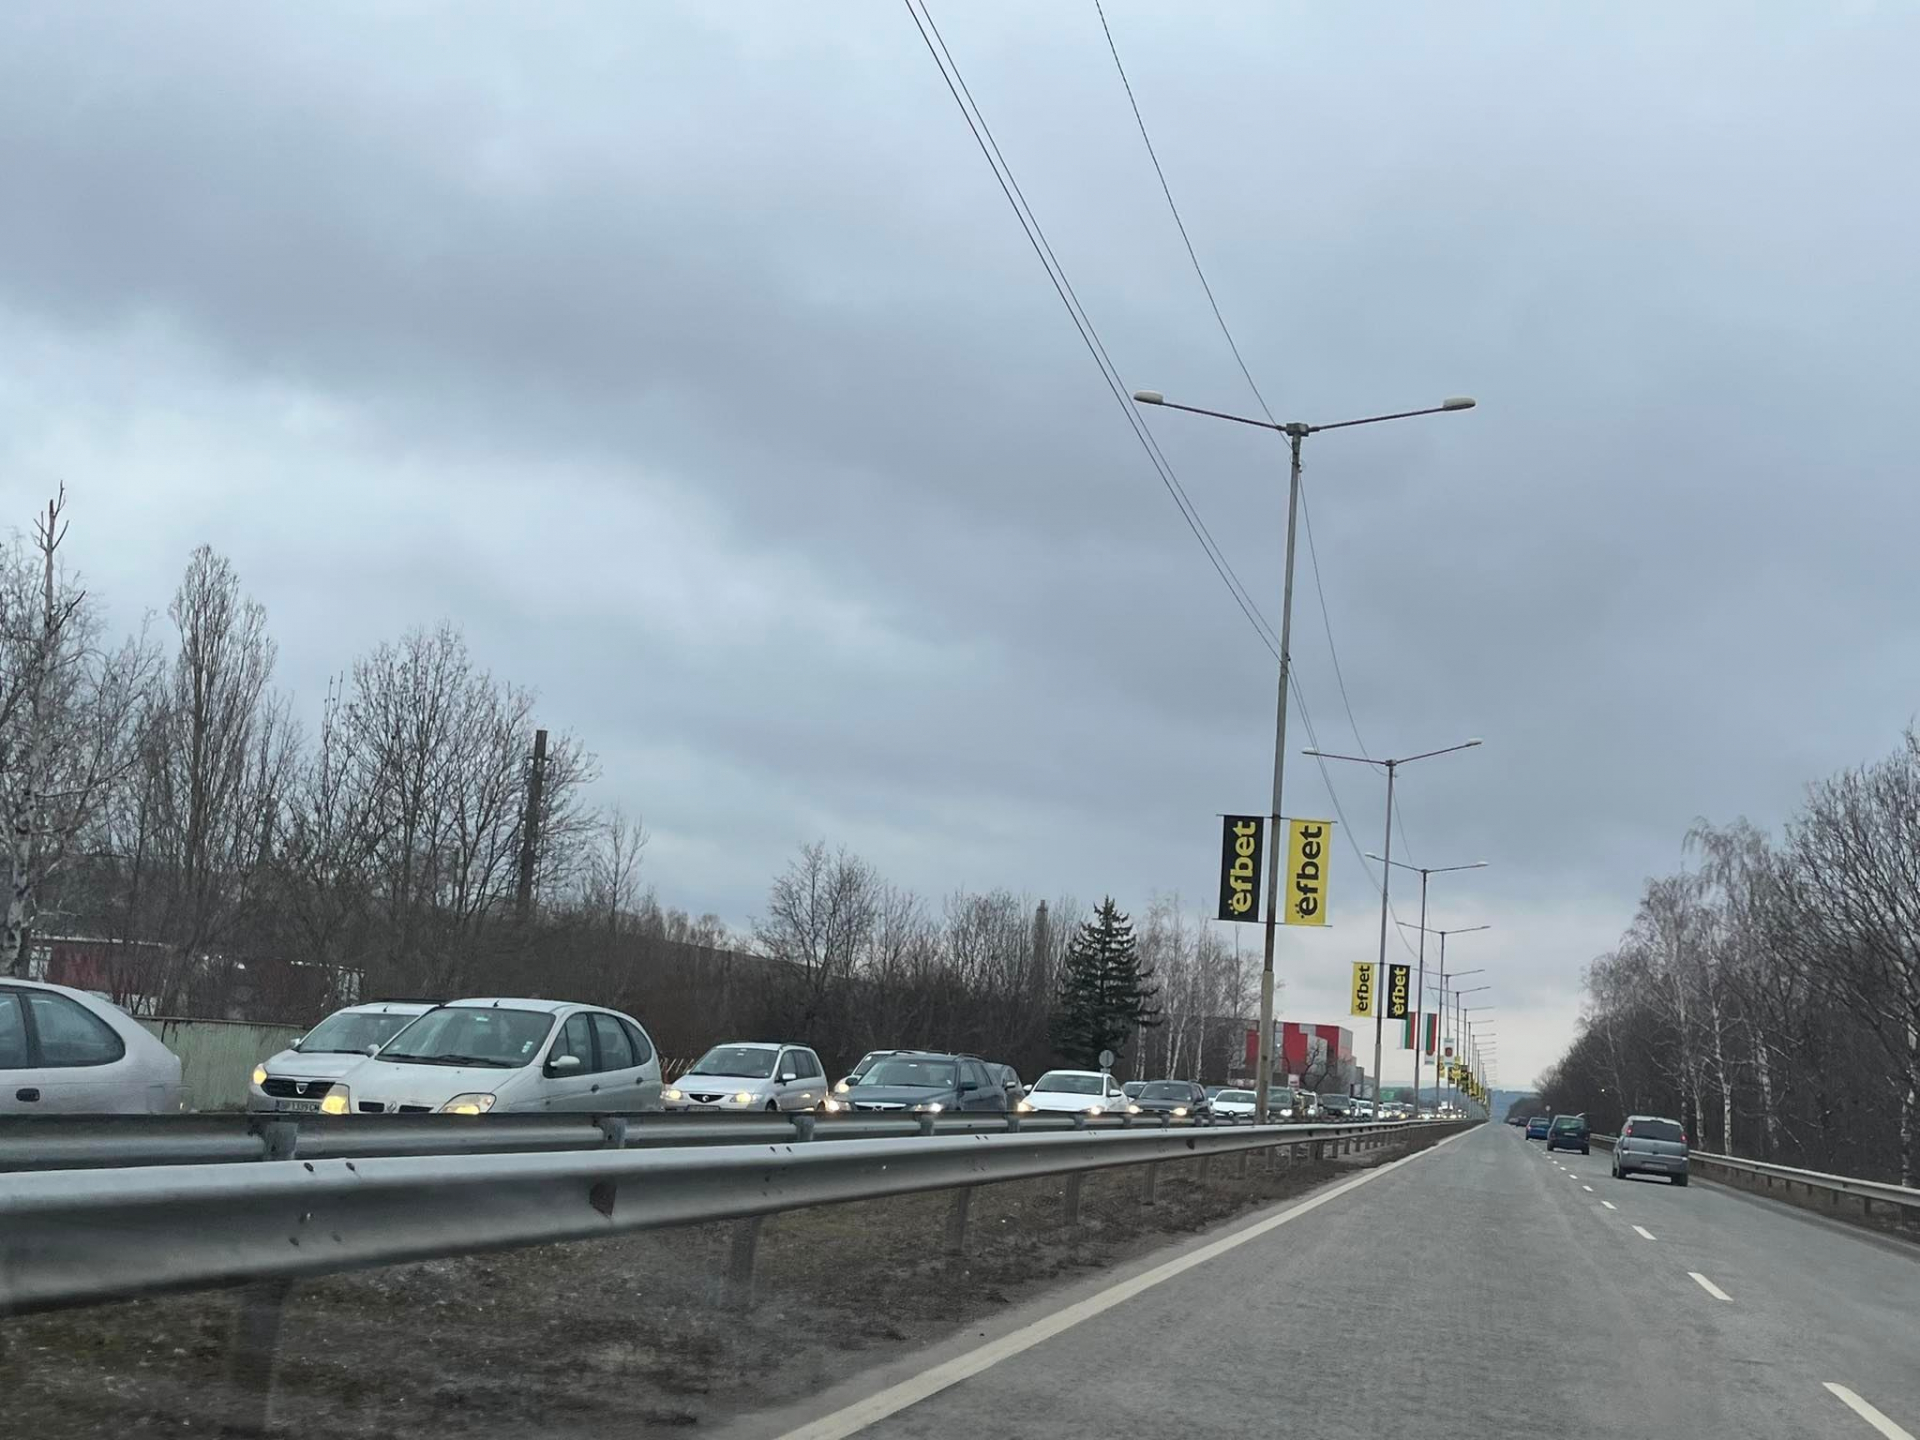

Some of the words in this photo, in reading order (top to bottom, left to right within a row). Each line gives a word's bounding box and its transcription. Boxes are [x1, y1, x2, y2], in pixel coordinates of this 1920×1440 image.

[1228, 821, 1257, 915] efbet
[1295, 825, 1323, 919] efbet
[1356, 965, 1371, 1012] efbet
[1391, 967, 1407, 1016] efbet
